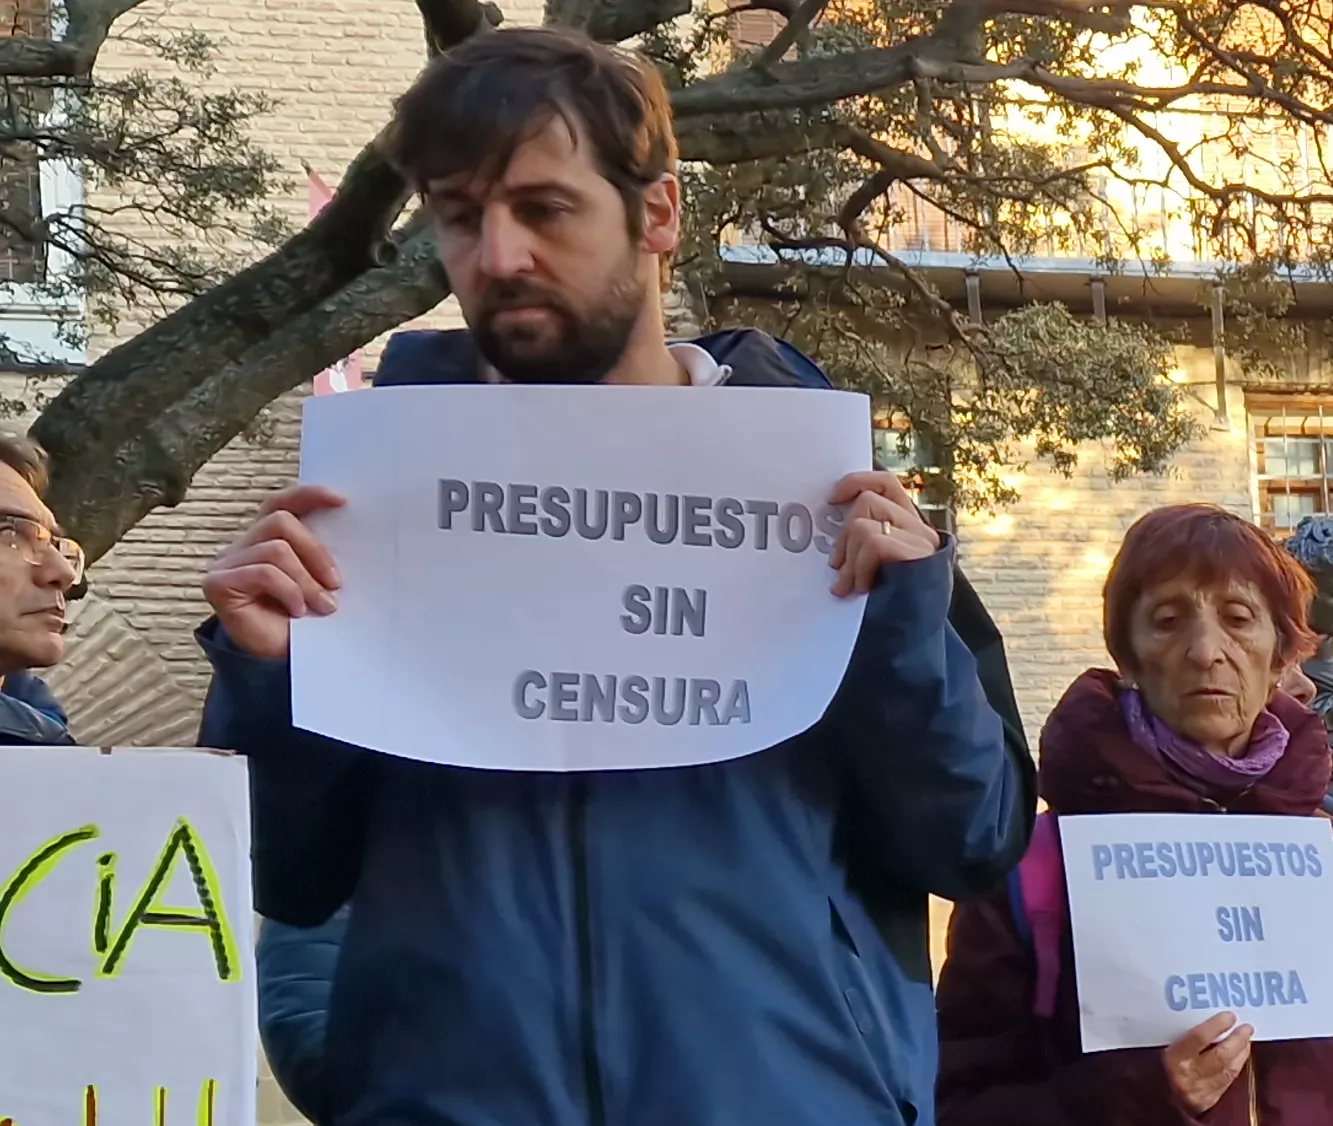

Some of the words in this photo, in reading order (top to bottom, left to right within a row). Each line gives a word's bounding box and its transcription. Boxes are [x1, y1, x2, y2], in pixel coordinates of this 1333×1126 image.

[437, 478, 845, 554] PRESUPUESTOS
[619, 584, 707, 637] SIN
[512, 669, 751, 725] CENSURA
[1091, 842, 1322, 880] PRESUPUESTOS
[1216, 906, 1264, 942] SIN
[1164, 970, 1307, 1012] CENSURA
